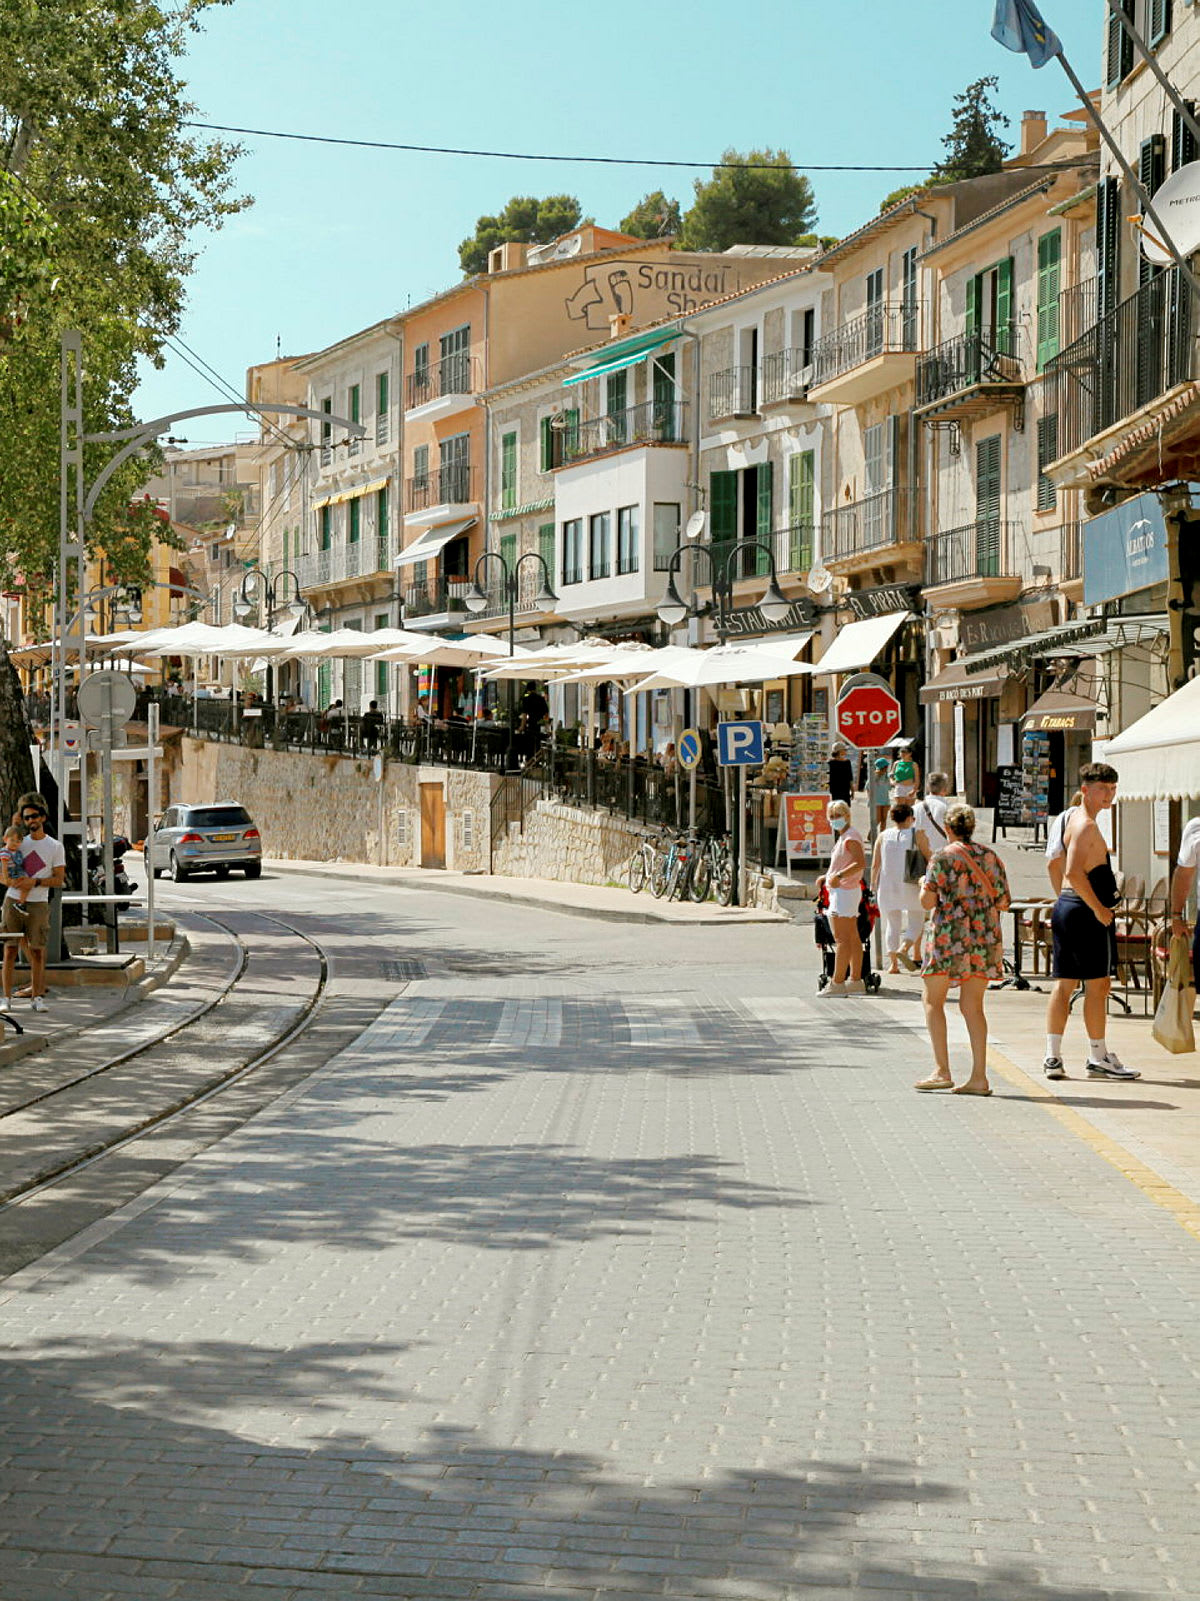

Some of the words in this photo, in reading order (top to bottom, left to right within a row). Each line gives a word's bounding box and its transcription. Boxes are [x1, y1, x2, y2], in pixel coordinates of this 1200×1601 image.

[638, 265, 726, 293] Sandal
[850, 597, 868, 618] EL
[868, 590, 909, 613] PIRATA
[841, 710, 897, 725] STOP
[727, 726, 754, 760] P
